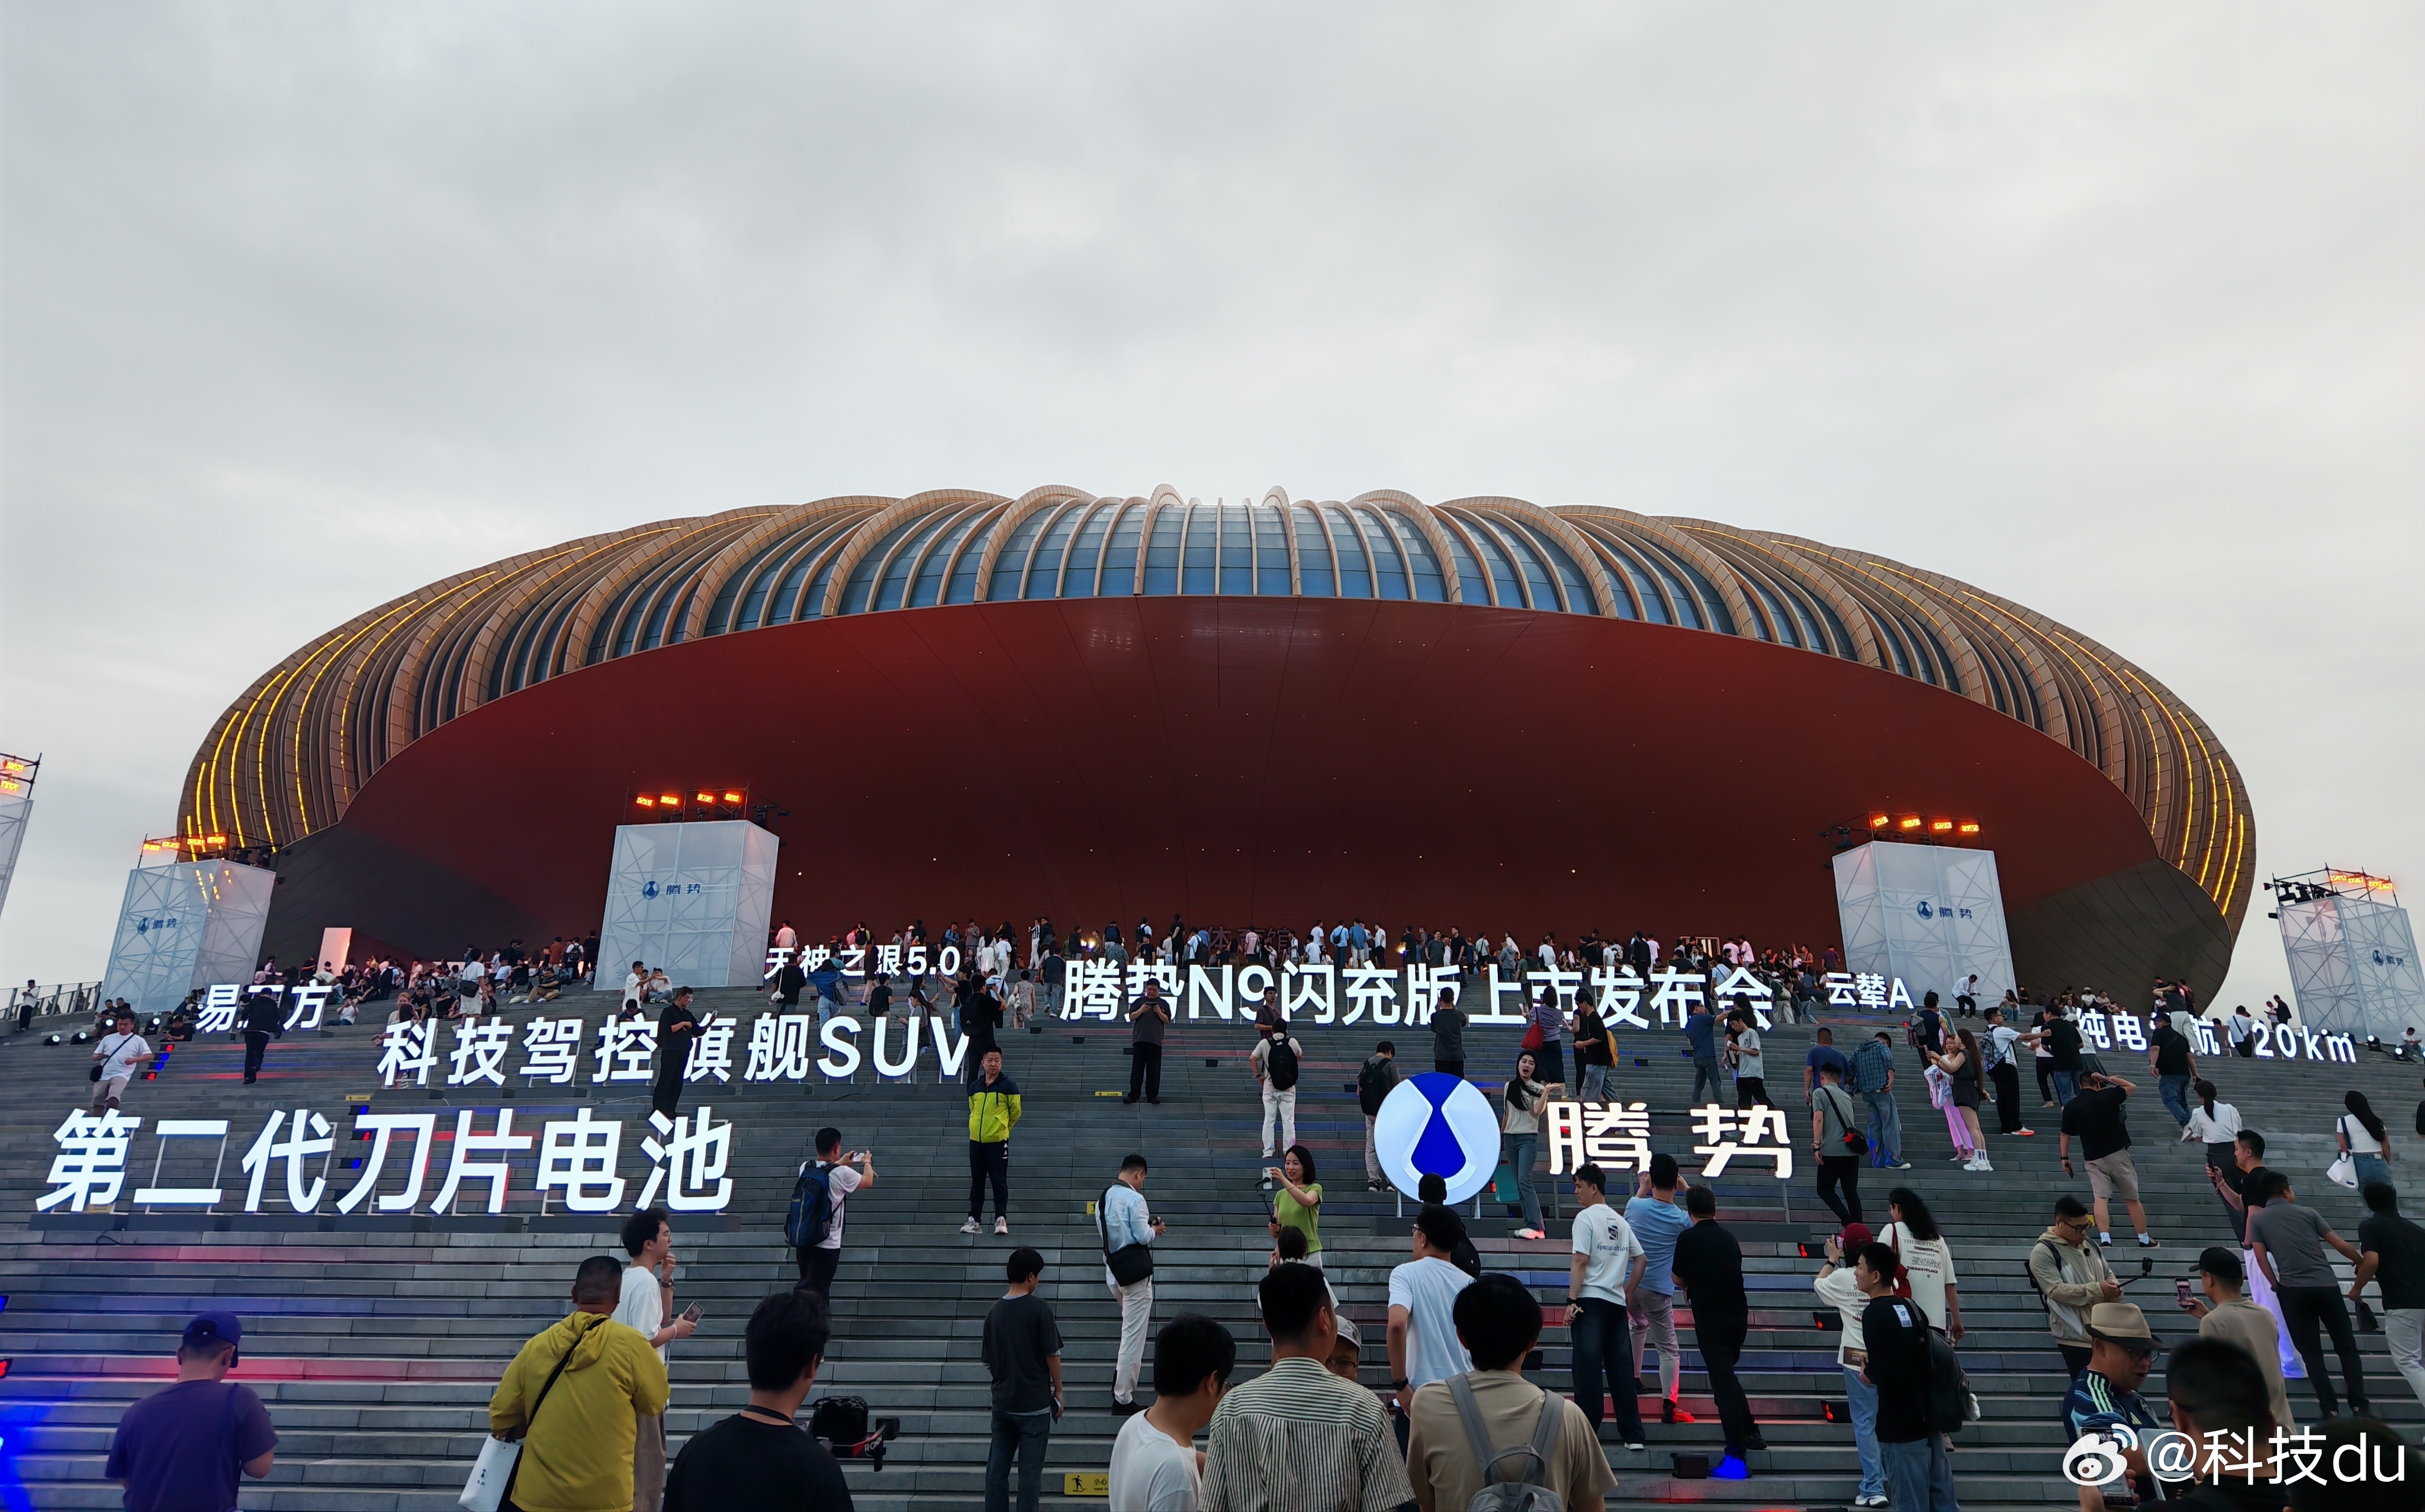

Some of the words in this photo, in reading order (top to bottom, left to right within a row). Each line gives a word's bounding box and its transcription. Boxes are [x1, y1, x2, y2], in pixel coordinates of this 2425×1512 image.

[36, 1106, 733, 1215] 第二代刀片电池
[1547, 1101, 1793, 1179] 腾势
